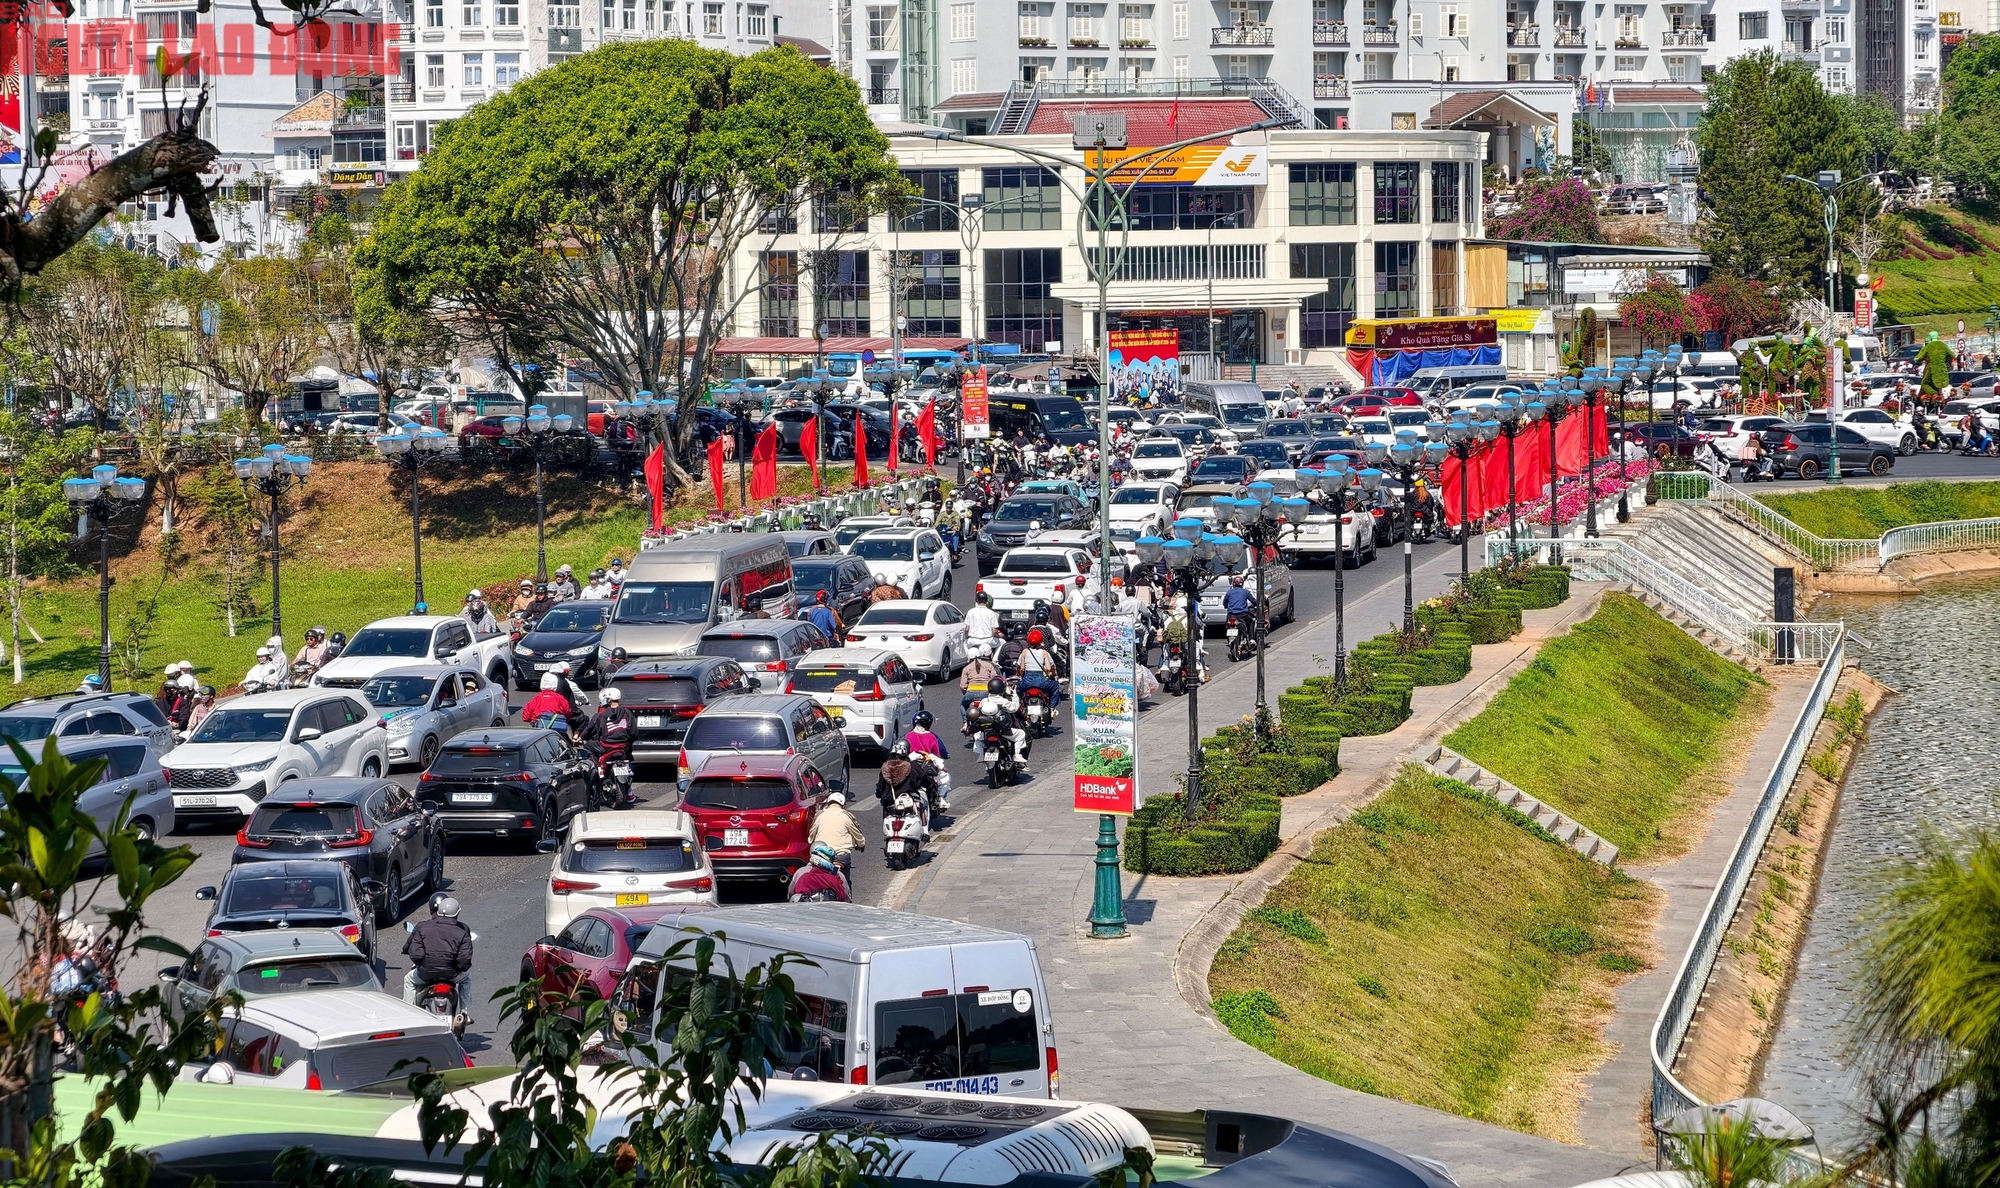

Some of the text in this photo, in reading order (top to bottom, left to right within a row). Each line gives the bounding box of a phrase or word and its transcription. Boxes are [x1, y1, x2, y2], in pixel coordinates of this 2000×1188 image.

[1400, 337, 1415, 345] Kho
[1081, 675, 1107, 683] QUANG
[1080, 783, 1116, 795] HDBank
